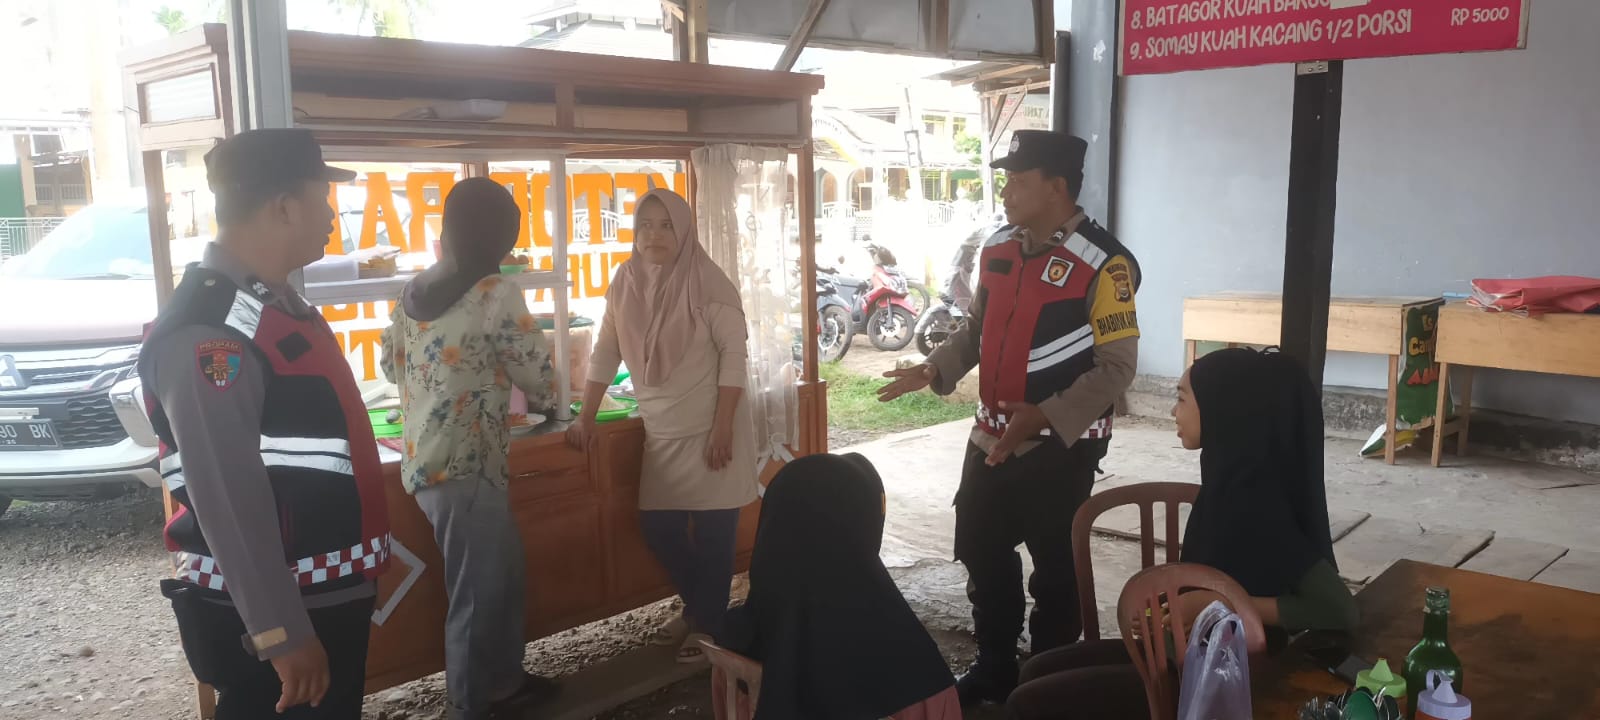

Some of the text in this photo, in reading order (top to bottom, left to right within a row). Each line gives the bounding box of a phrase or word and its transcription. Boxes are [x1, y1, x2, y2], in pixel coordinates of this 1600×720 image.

[1130, 10, 1143, 30] 8.
[1146, 0, 1221, 28] BATAGOR
[1223, 0, 1271, 18] KUAH
[1450, 6, 1509, 26] RP 5000
[1130, 10, 1412, 60] 9. SOMAY KUAH KACANG 1/2 PORSI
[29, 423, 51, 438] BK
